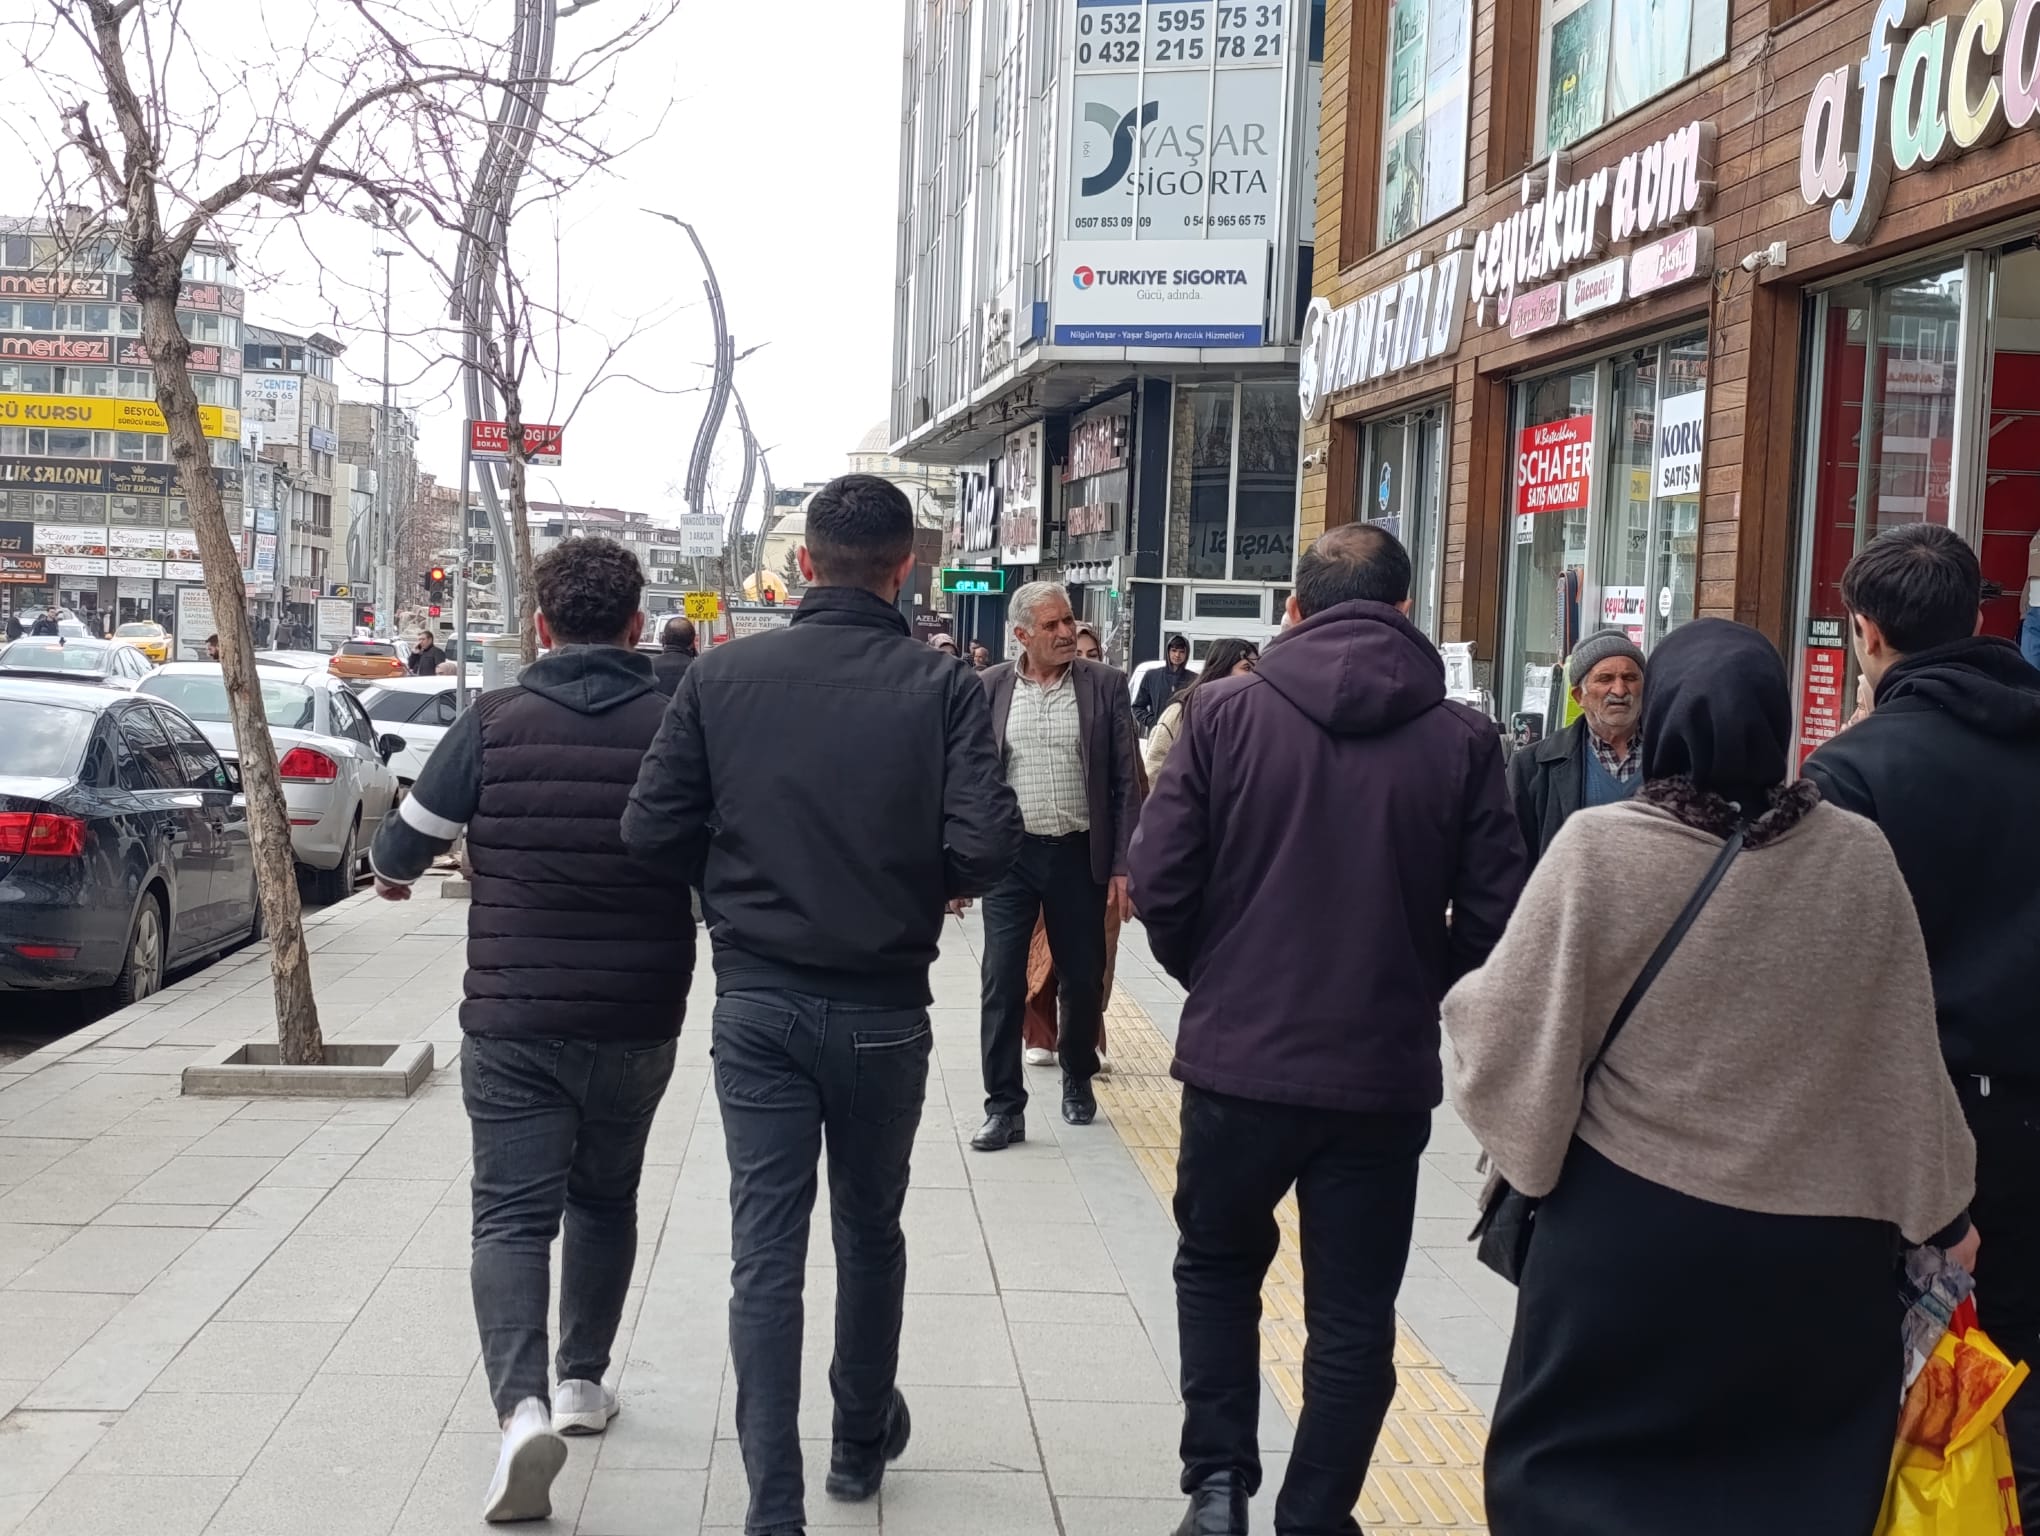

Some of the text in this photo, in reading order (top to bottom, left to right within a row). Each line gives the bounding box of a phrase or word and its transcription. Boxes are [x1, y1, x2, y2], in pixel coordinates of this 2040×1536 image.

[1080, 4, 1282, 36] 0 532 595 75 31
[1079, 34, 1281, 64] 0 432 215 78 21
[1127, 123, 1268, 167] YAŞAR
[1125, 166, 1268, 196] SİGORTA
[1611, 120, 1700, 243] avm
[1075, 217, 1151, 229] 0507 853 09 09
[1184, 215, 1190, 227] 0
[1217, 215, 1236, 227] 965
[1238, 215, 1251, 226] 65
[1253, 214, 1266, 226] 75
[0, 272, 109, 295] merkezi
[1172, 269, 1248, 285] SİGORTA
[1070, 330, 1095, 341] Nilgün
[1096, 331, 1117, 341] Yaşar
[1122, 331, 1143, 341] Yaşar
[1145, 331, 1173, 341] Sigorta
[1205, 331, 1245, 341] Hizmetleri
[2, 335, 110, 358] merkezi
[245, 390, 294, 400] 927 65 65
[263, 379, 299, 392] CENTER
[25, 404, 92, 421] KURSU
[124, 406, 160, 417] BEŞYOL
[33, 466, 103, 485] SALONU
[1663, 464, 1692, 491] SATIŞ
[1546, 481, 1580, 505] NOKTASI
